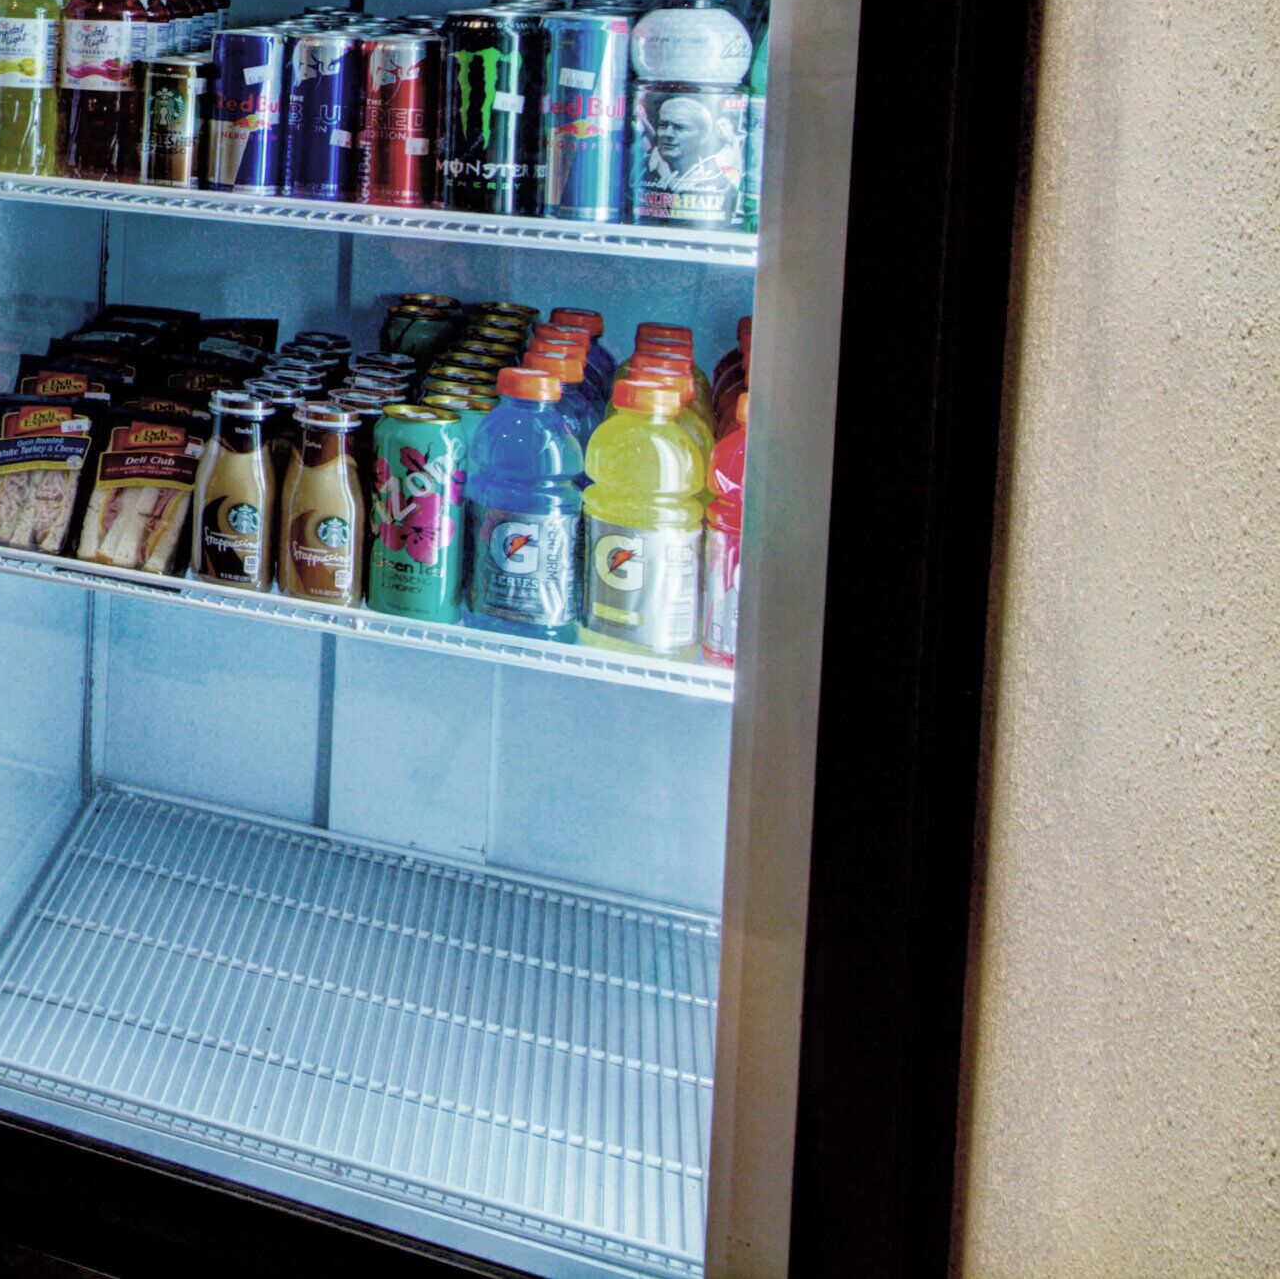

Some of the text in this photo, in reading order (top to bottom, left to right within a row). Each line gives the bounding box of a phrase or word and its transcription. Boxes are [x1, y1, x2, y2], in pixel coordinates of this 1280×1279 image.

[76, 25, 108, 43] Crystal
[289, 94, 305, 102] THE
[366, 98, 383, 106] THE
[541, 94, 626, 118] Red Bull
[435, 157, 529, 180] MONSTER
[49, 377, 74, 388] Deli
[33, 410, 56, 421] Deli
[134, 434, 179, 444] Express
[144, 429, 168, 438] Deli
[16, 438, 34, 447] Oven
[20, 444, 47, 454] Turkey
[54, 444, 85, 454] Cheese
[125, 455, 176, 466] Deli Club
[490, 521, 540, 574] G
[293, 540, 352, 567] frappuccino
[594, 534, 644, 592] G
